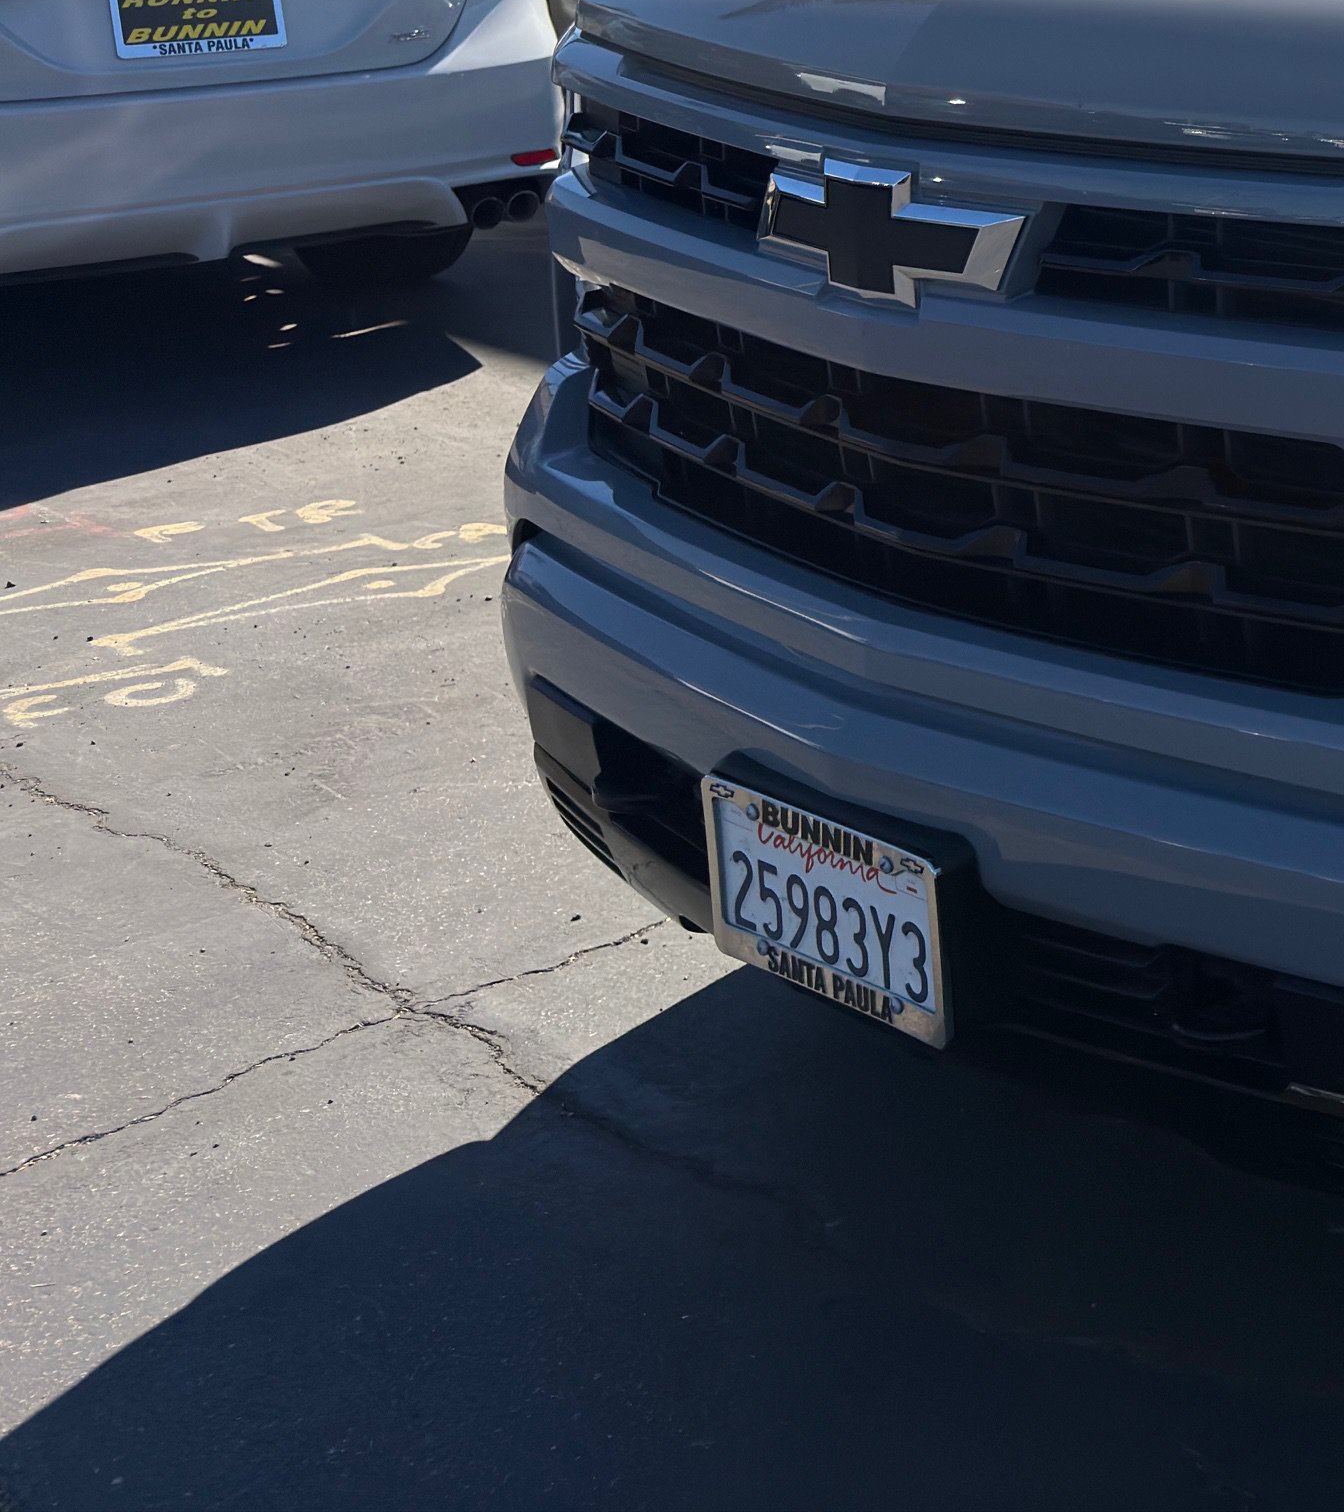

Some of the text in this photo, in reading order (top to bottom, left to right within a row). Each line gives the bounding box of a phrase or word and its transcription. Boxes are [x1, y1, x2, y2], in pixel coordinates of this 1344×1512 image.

[126, 19, 267, 44] BUNNIN
[182, 7, 218, 20] to
[159, 38, 250, 56] SANTA PAULA
[761, 799, 874, 866] BUNNIN
[732, 850, 929, 1004] 25983Y3
[768, 945, 894, 1025] SANTA PAULA
